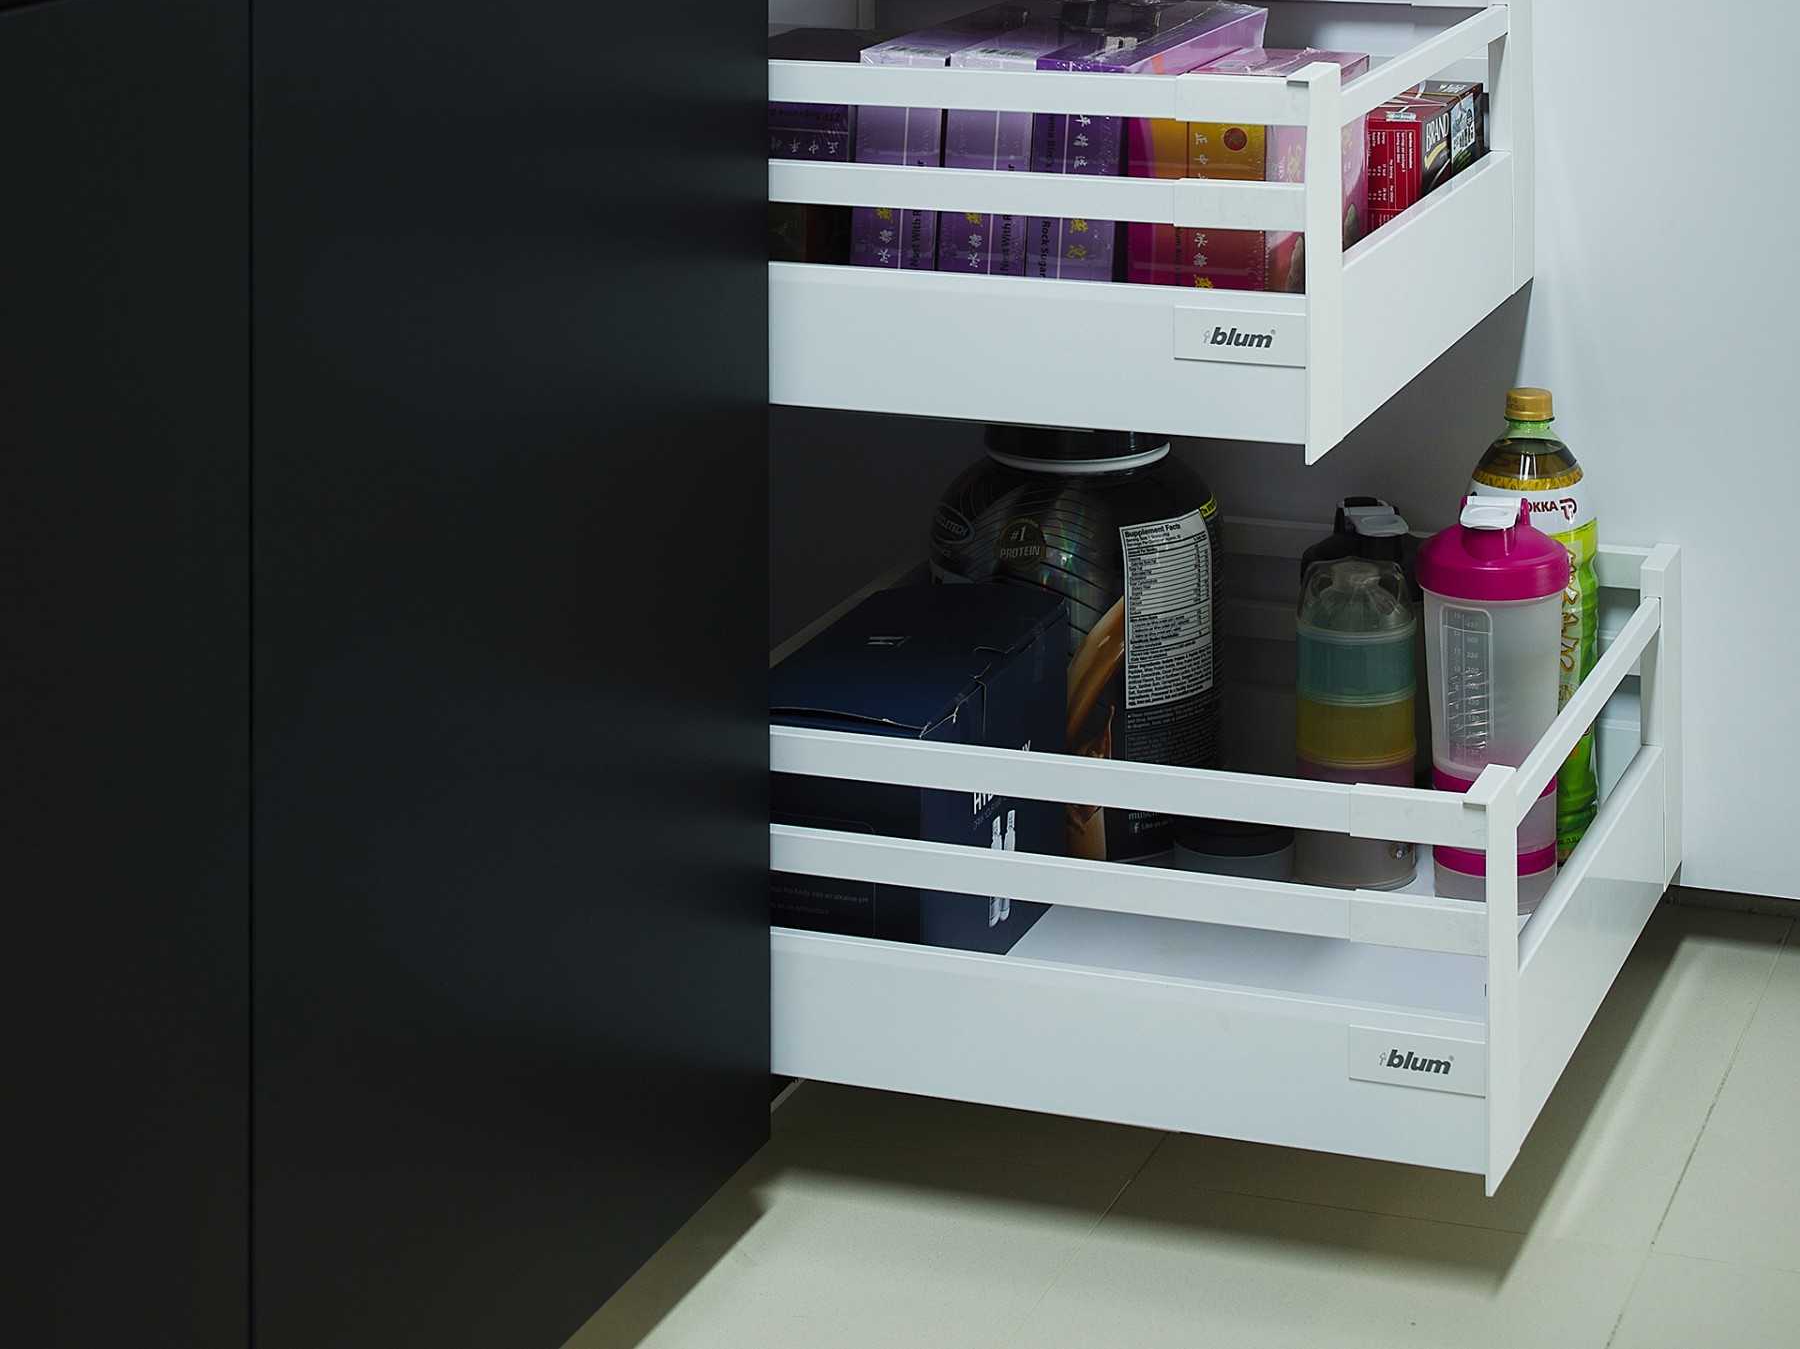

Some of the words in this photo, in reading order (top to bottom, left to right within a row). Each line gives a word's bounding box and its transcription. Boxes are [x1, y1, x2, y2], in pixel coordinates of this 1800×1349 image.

[1040, 219, 1052, 247] Rock
[1038, 248, 1051, 278] Sugar
[1209, 326, 1274, 350] blum
[1008, 525, 1027, 542] #1
[1000, 545, 1041, 559] PROTEIN
[1386, 1049, 1452, 1075] blum
